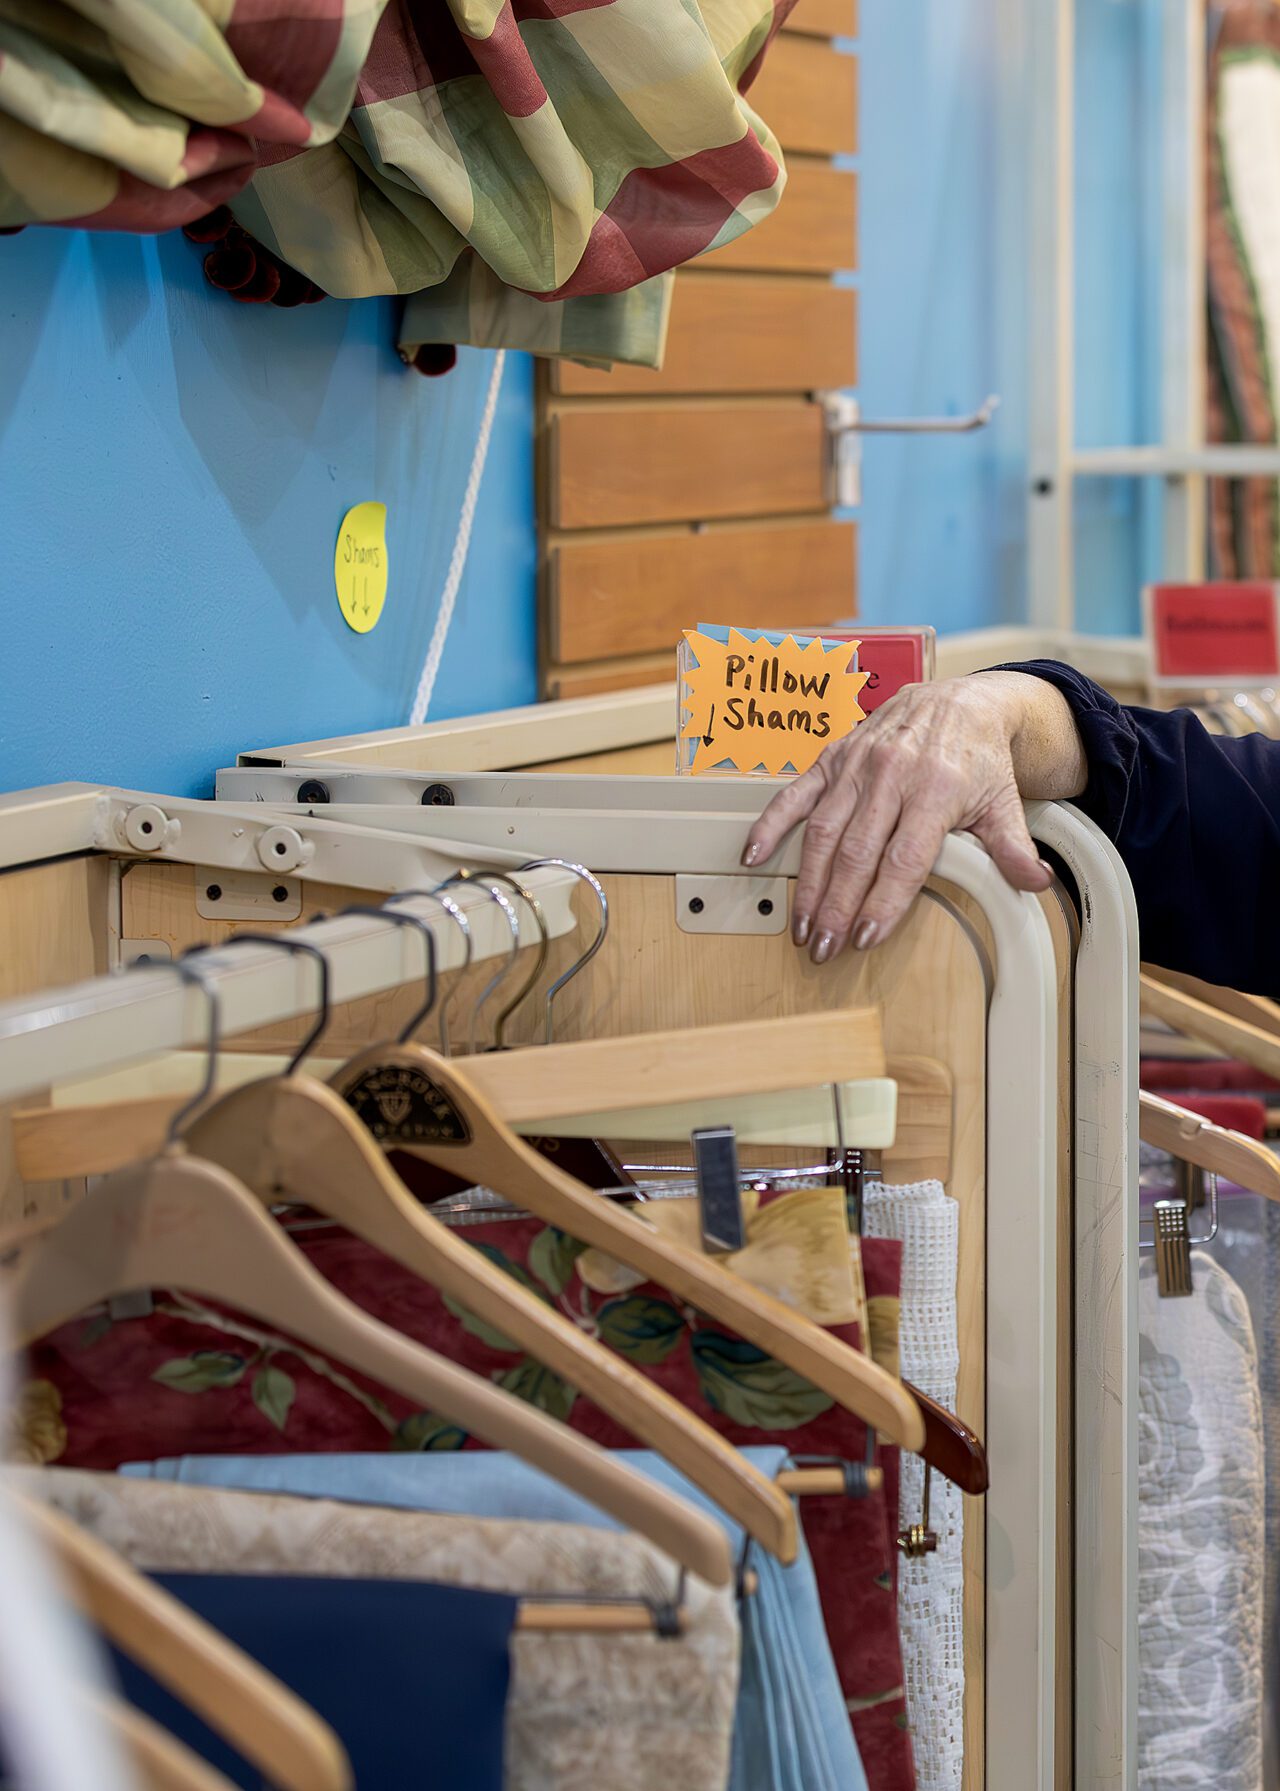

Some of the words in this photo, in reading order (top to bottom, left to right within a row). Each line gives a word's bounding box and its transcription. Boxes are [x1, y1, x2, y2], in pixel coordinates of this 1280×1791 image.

[344, 534, 379, 568] Shams
[725, 654, 830, 700] Pillow
[722, 697, 831, 738] Shams
